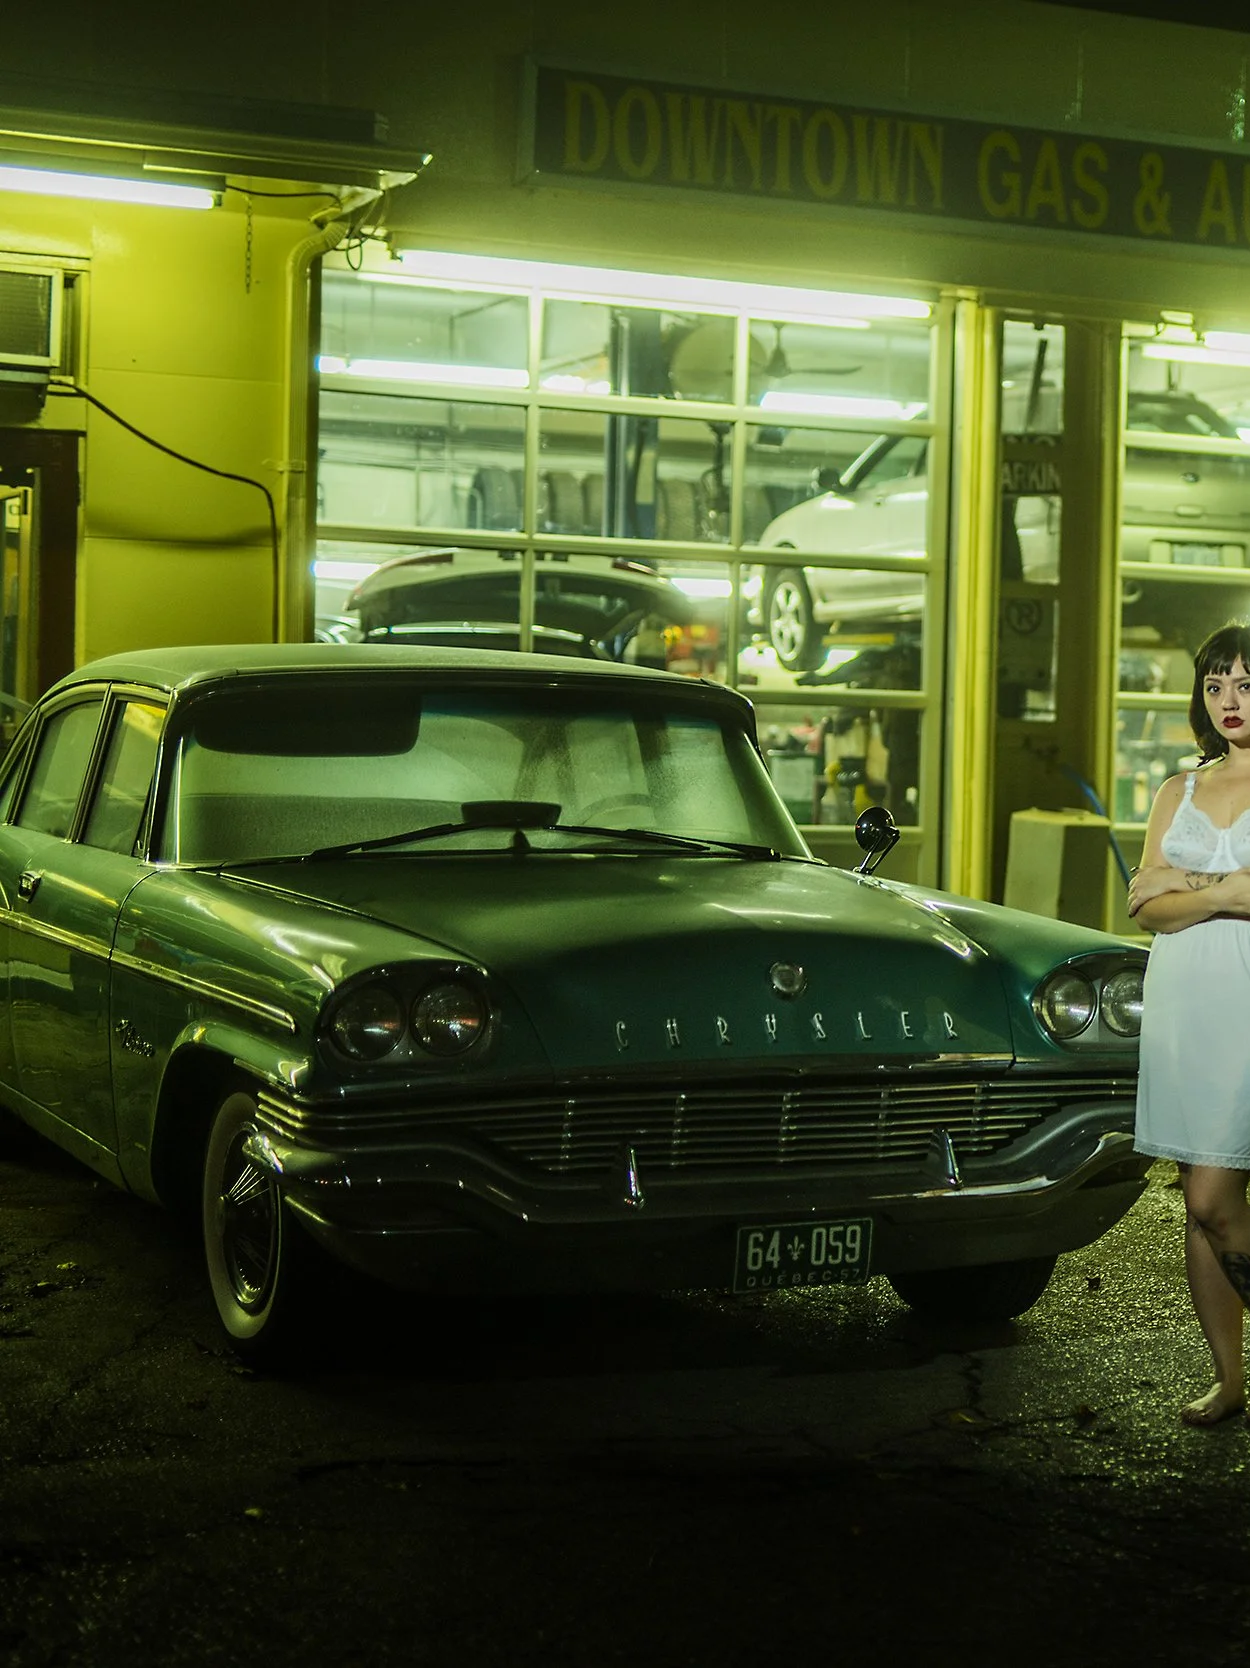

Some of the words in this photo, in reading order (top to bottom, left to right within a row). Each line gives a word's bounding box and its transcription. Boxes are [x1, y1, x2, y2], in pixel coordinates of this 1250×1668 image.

[562, 80, 944, 210] DOWNTOWN
[977, 128, 1109, 229] GAS
[1134, 152, 1171, 237] &
[615, 1010, 960, 1052] CHRYSLER
[746, 1229, 781, 1271] 64
[810, 1224, 862, 1266] 059
